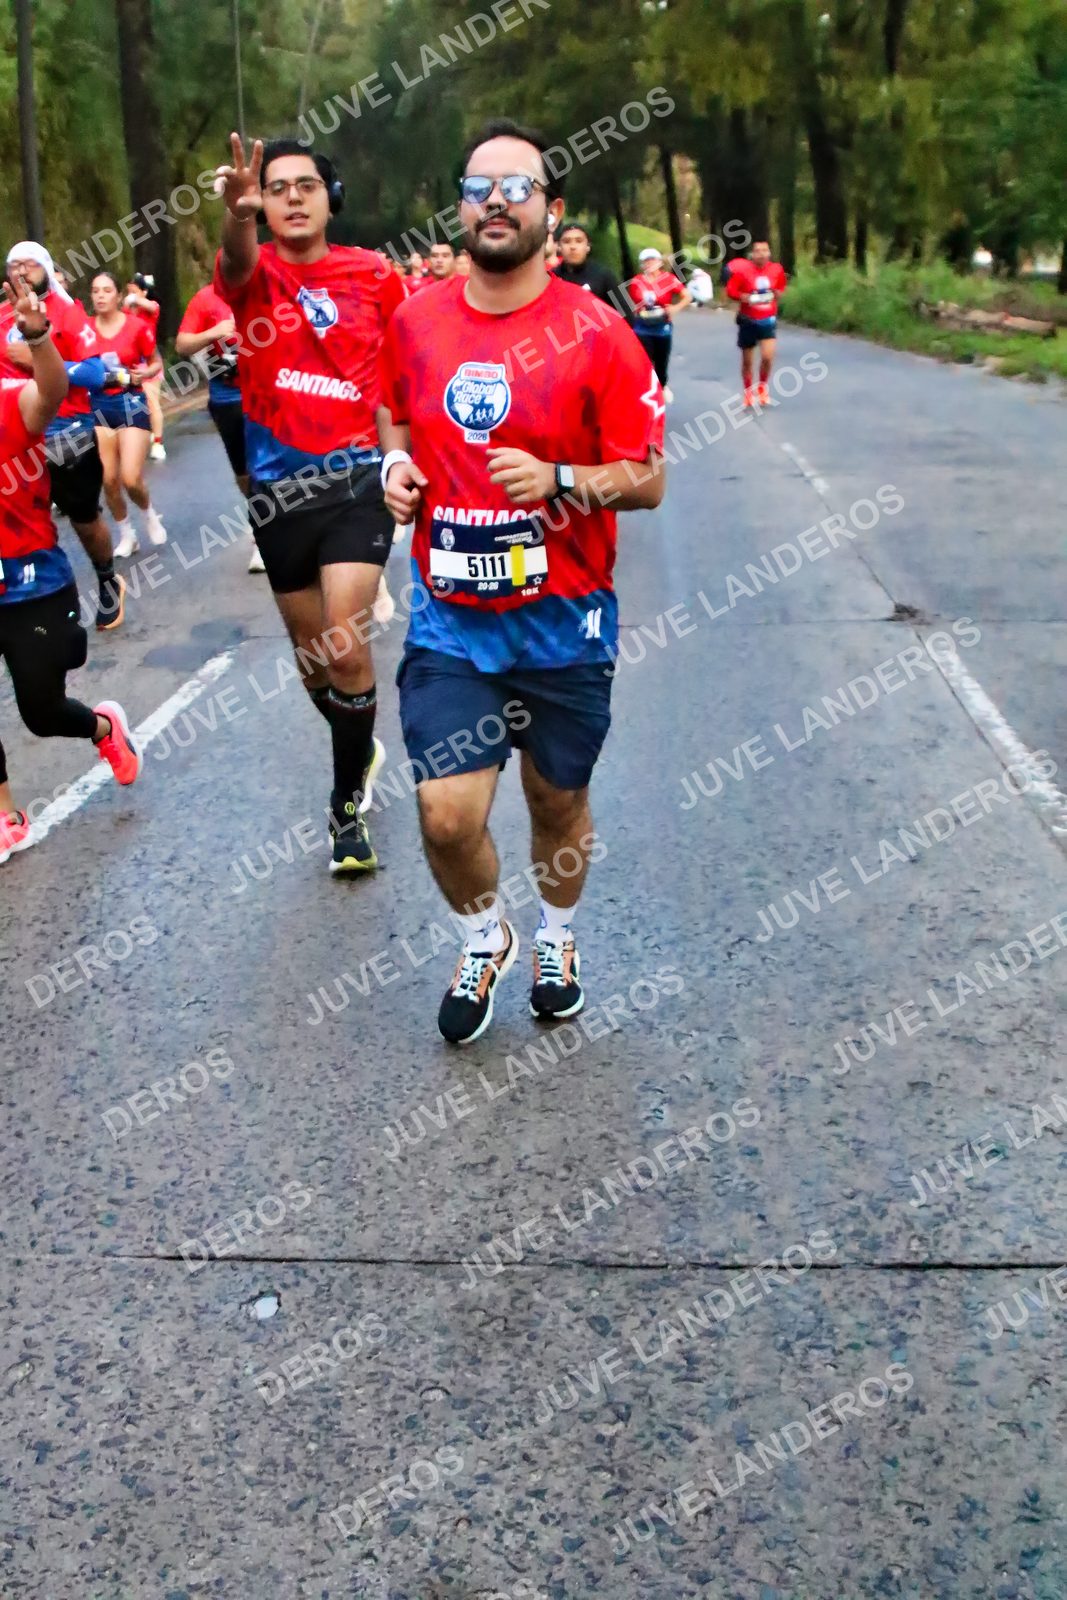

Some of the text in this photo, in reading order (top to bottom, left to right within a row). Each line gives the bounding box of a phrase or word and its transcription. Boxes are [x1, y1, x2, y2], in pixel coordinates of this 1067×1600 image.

[462, 381, 497, 395] Global
[453, 391, 482, 404] Race
[467, 555, 507, 578] 5111
[520, 587, 539, 597] 10K
